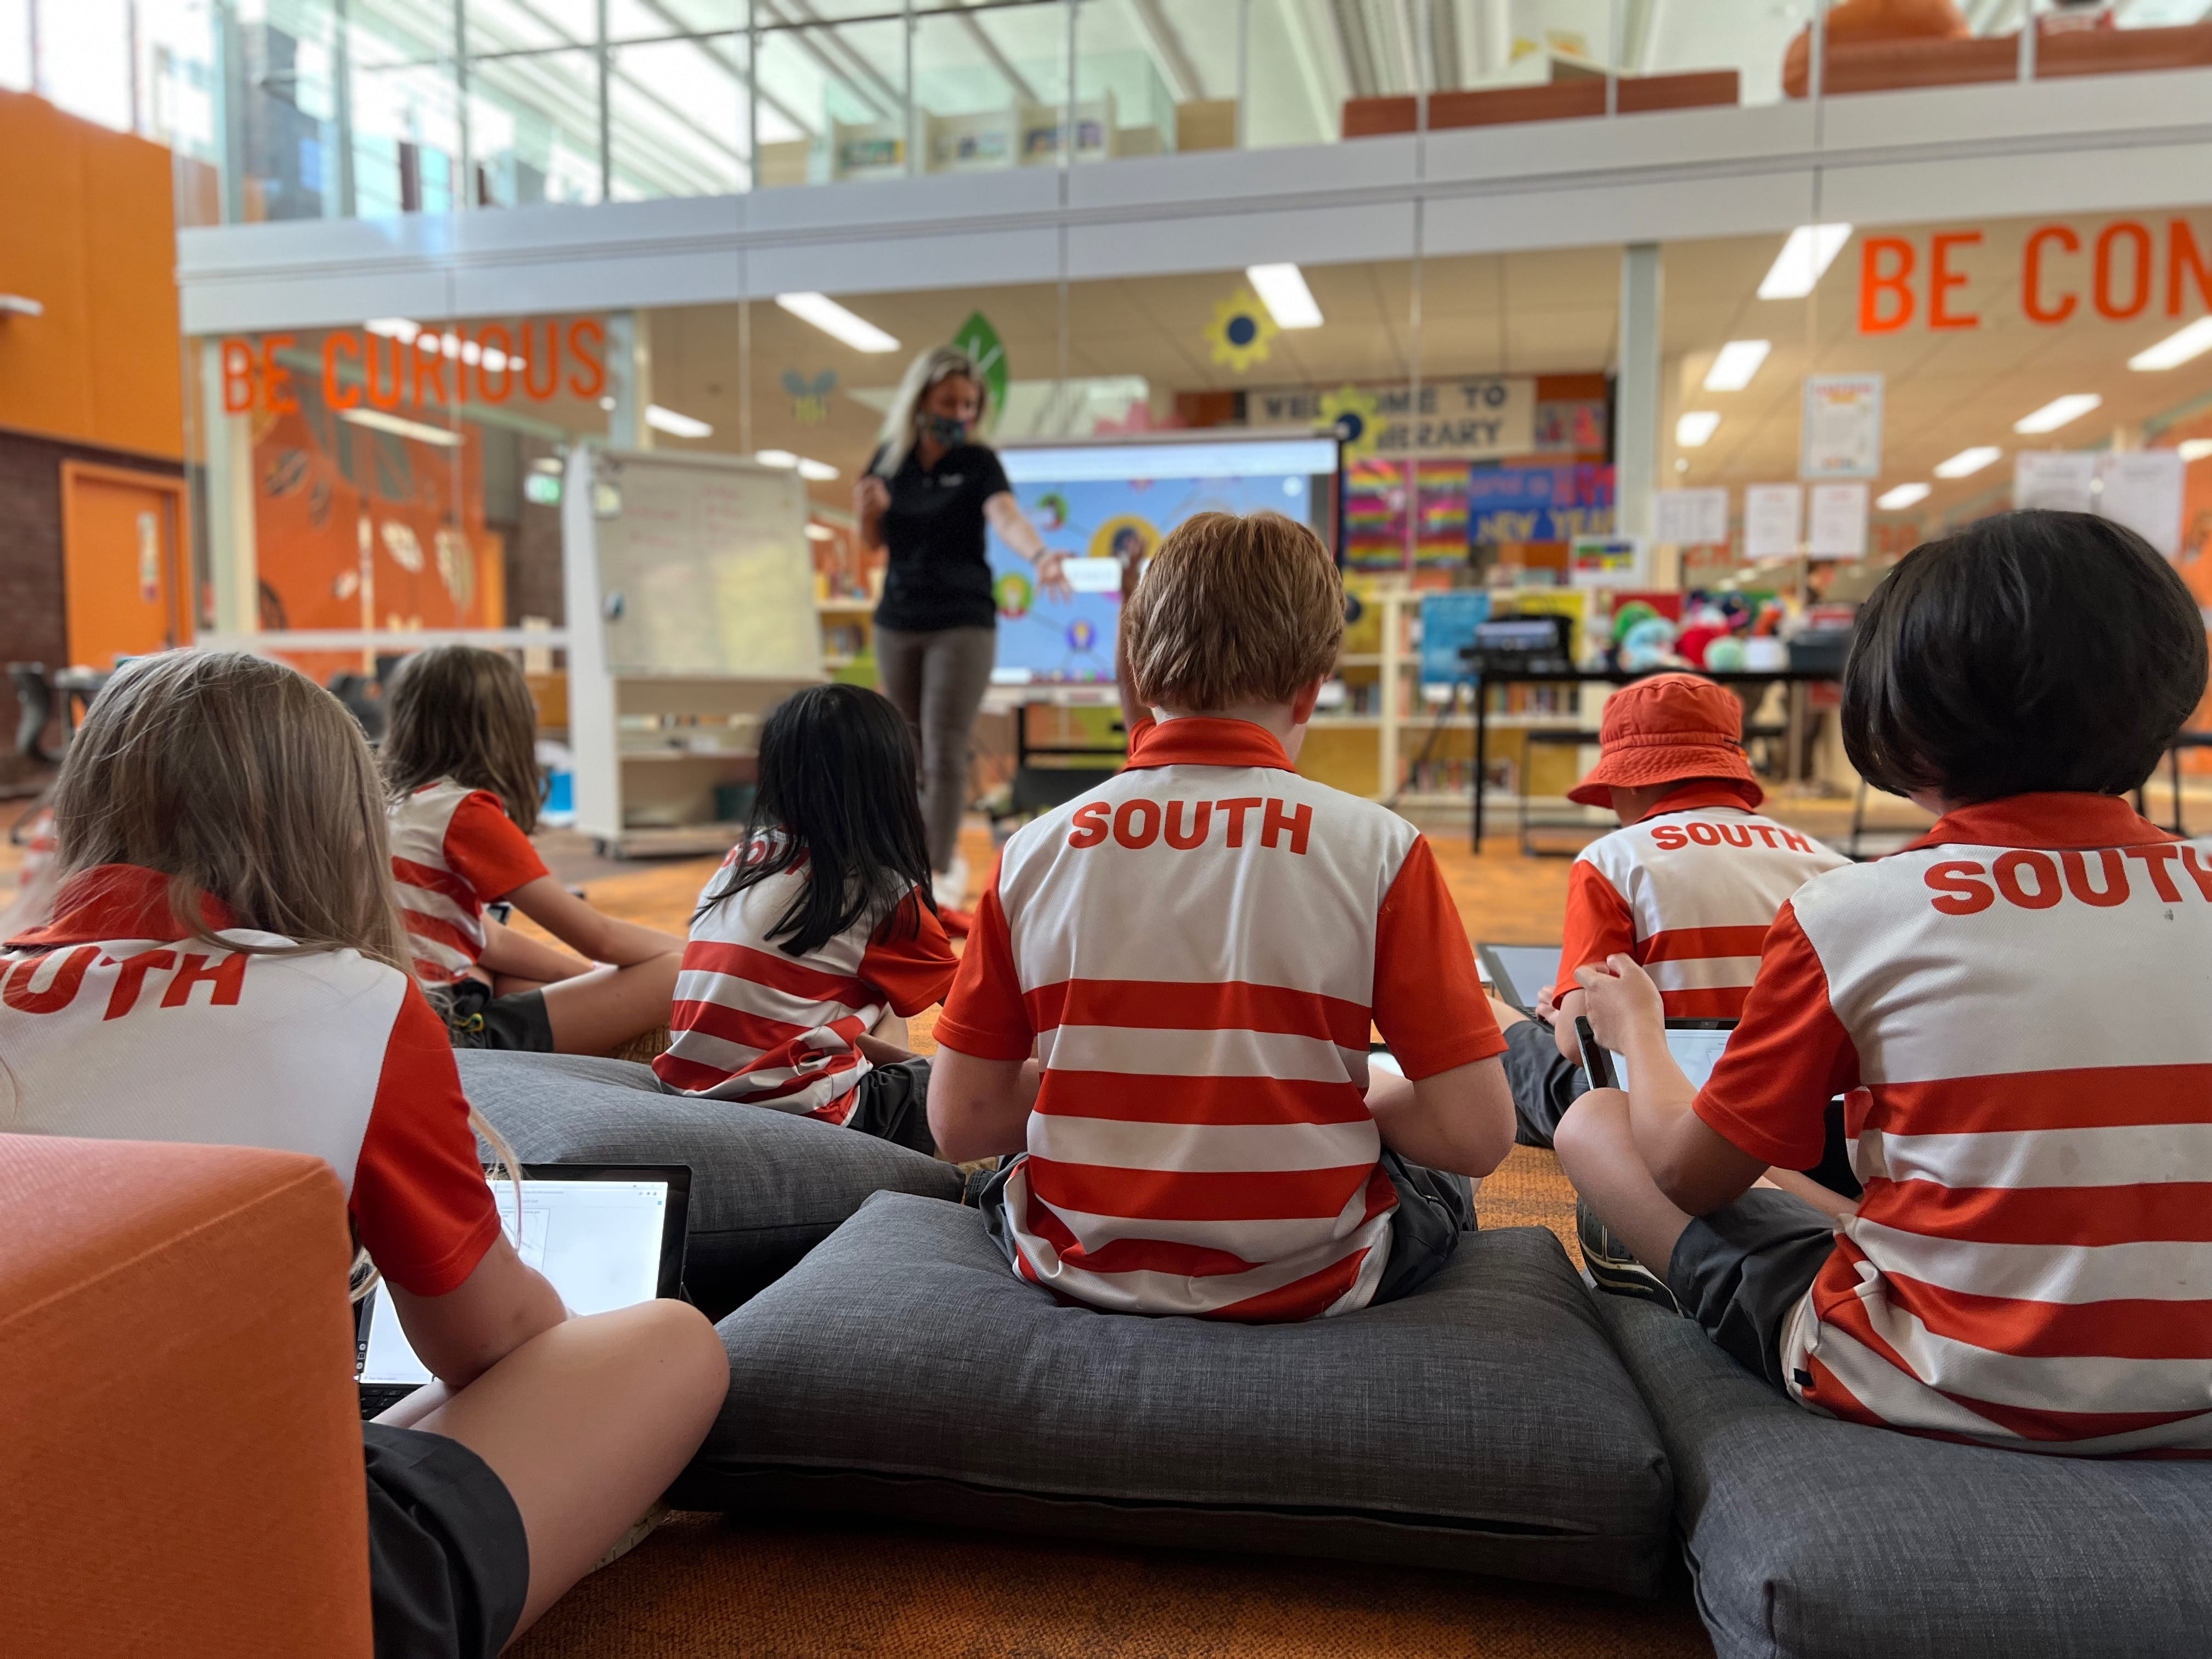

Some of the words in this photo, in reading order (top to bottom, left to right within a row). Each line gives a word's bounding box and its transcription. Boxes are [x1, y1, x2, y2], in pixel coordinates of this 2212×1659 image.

[1859, 229, 1982, 336] BE
[220, 334, 299, 415] BE
[322, 317, 606, 410] CURIOUS
[1462, 382, 1506, 410] TO
[1068, 797, 1313, 855] SOUTH
[1651, 822, 1815, 854] SOUTH
[0, 946, 250, 1022] UTH
